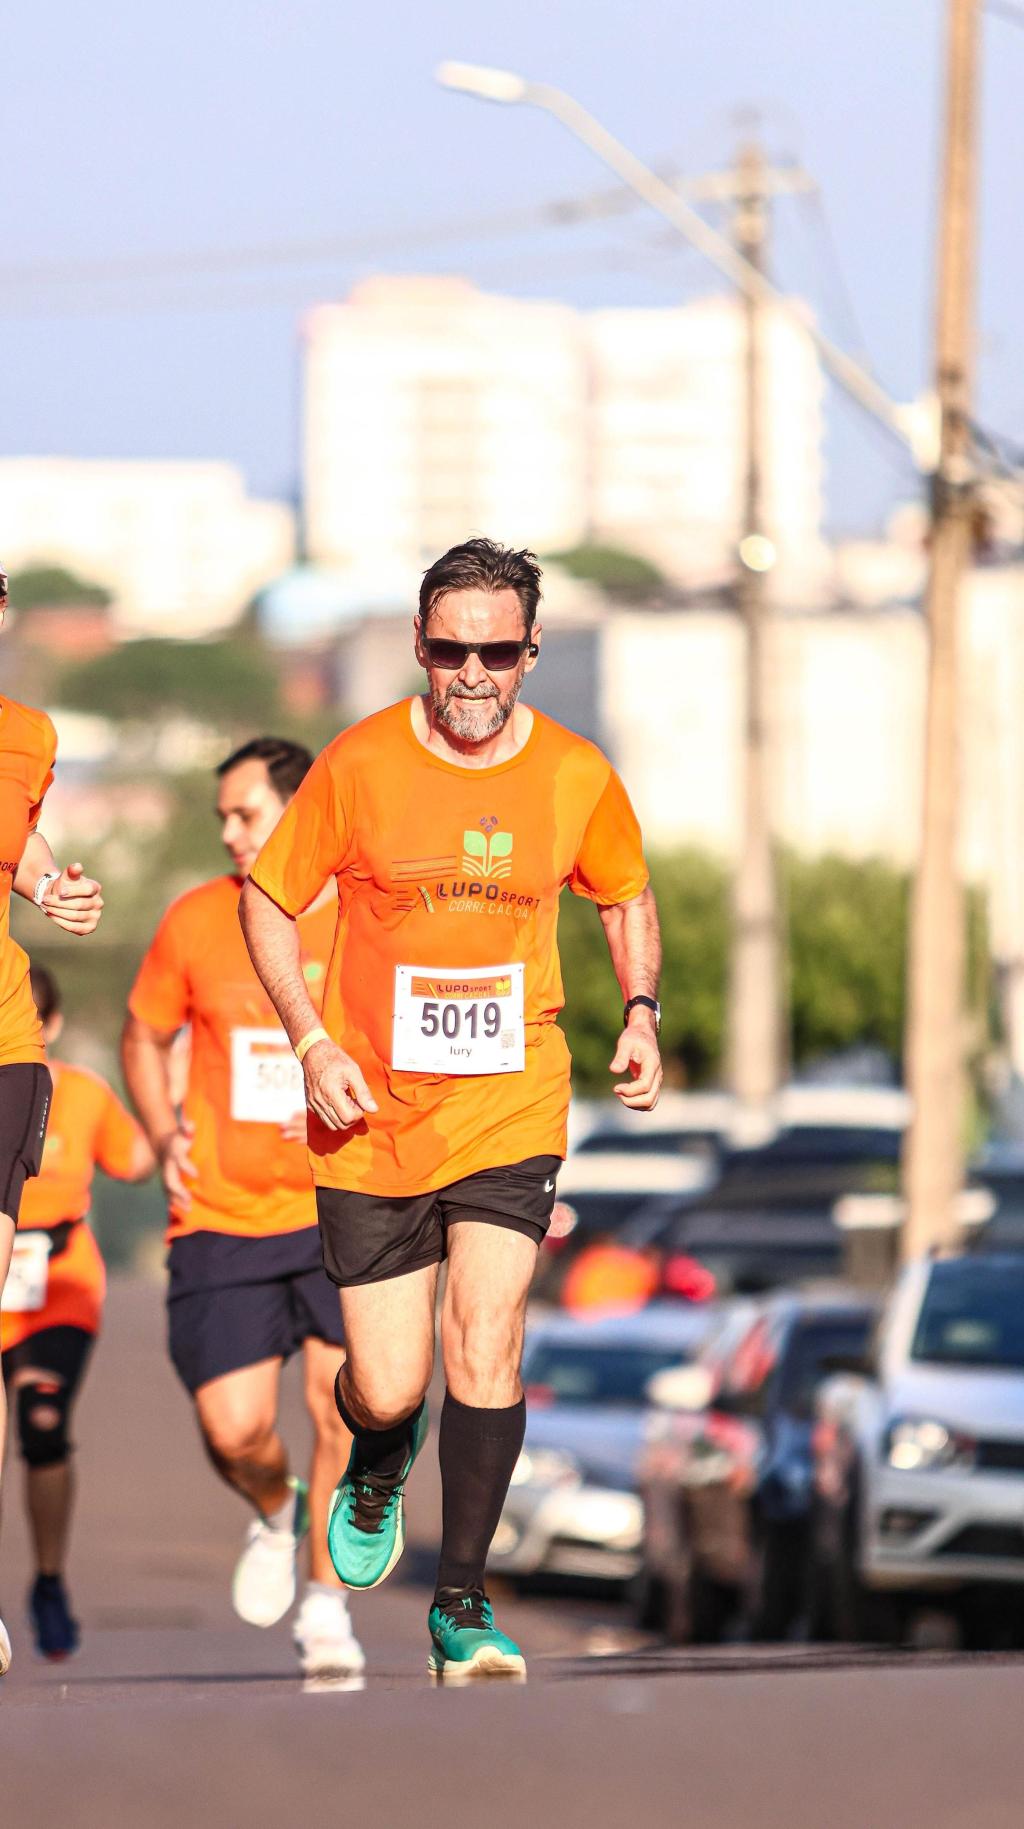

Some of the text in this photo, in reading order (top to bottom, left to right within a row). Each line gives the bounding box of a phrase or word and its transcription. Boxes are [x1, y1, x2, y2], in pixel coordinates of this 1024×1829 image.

[437, 881, 541, 909] LUPO SPORT
[437, 984, 469, 993] LUPO
[420, 1002, 502, 1039] 5019
